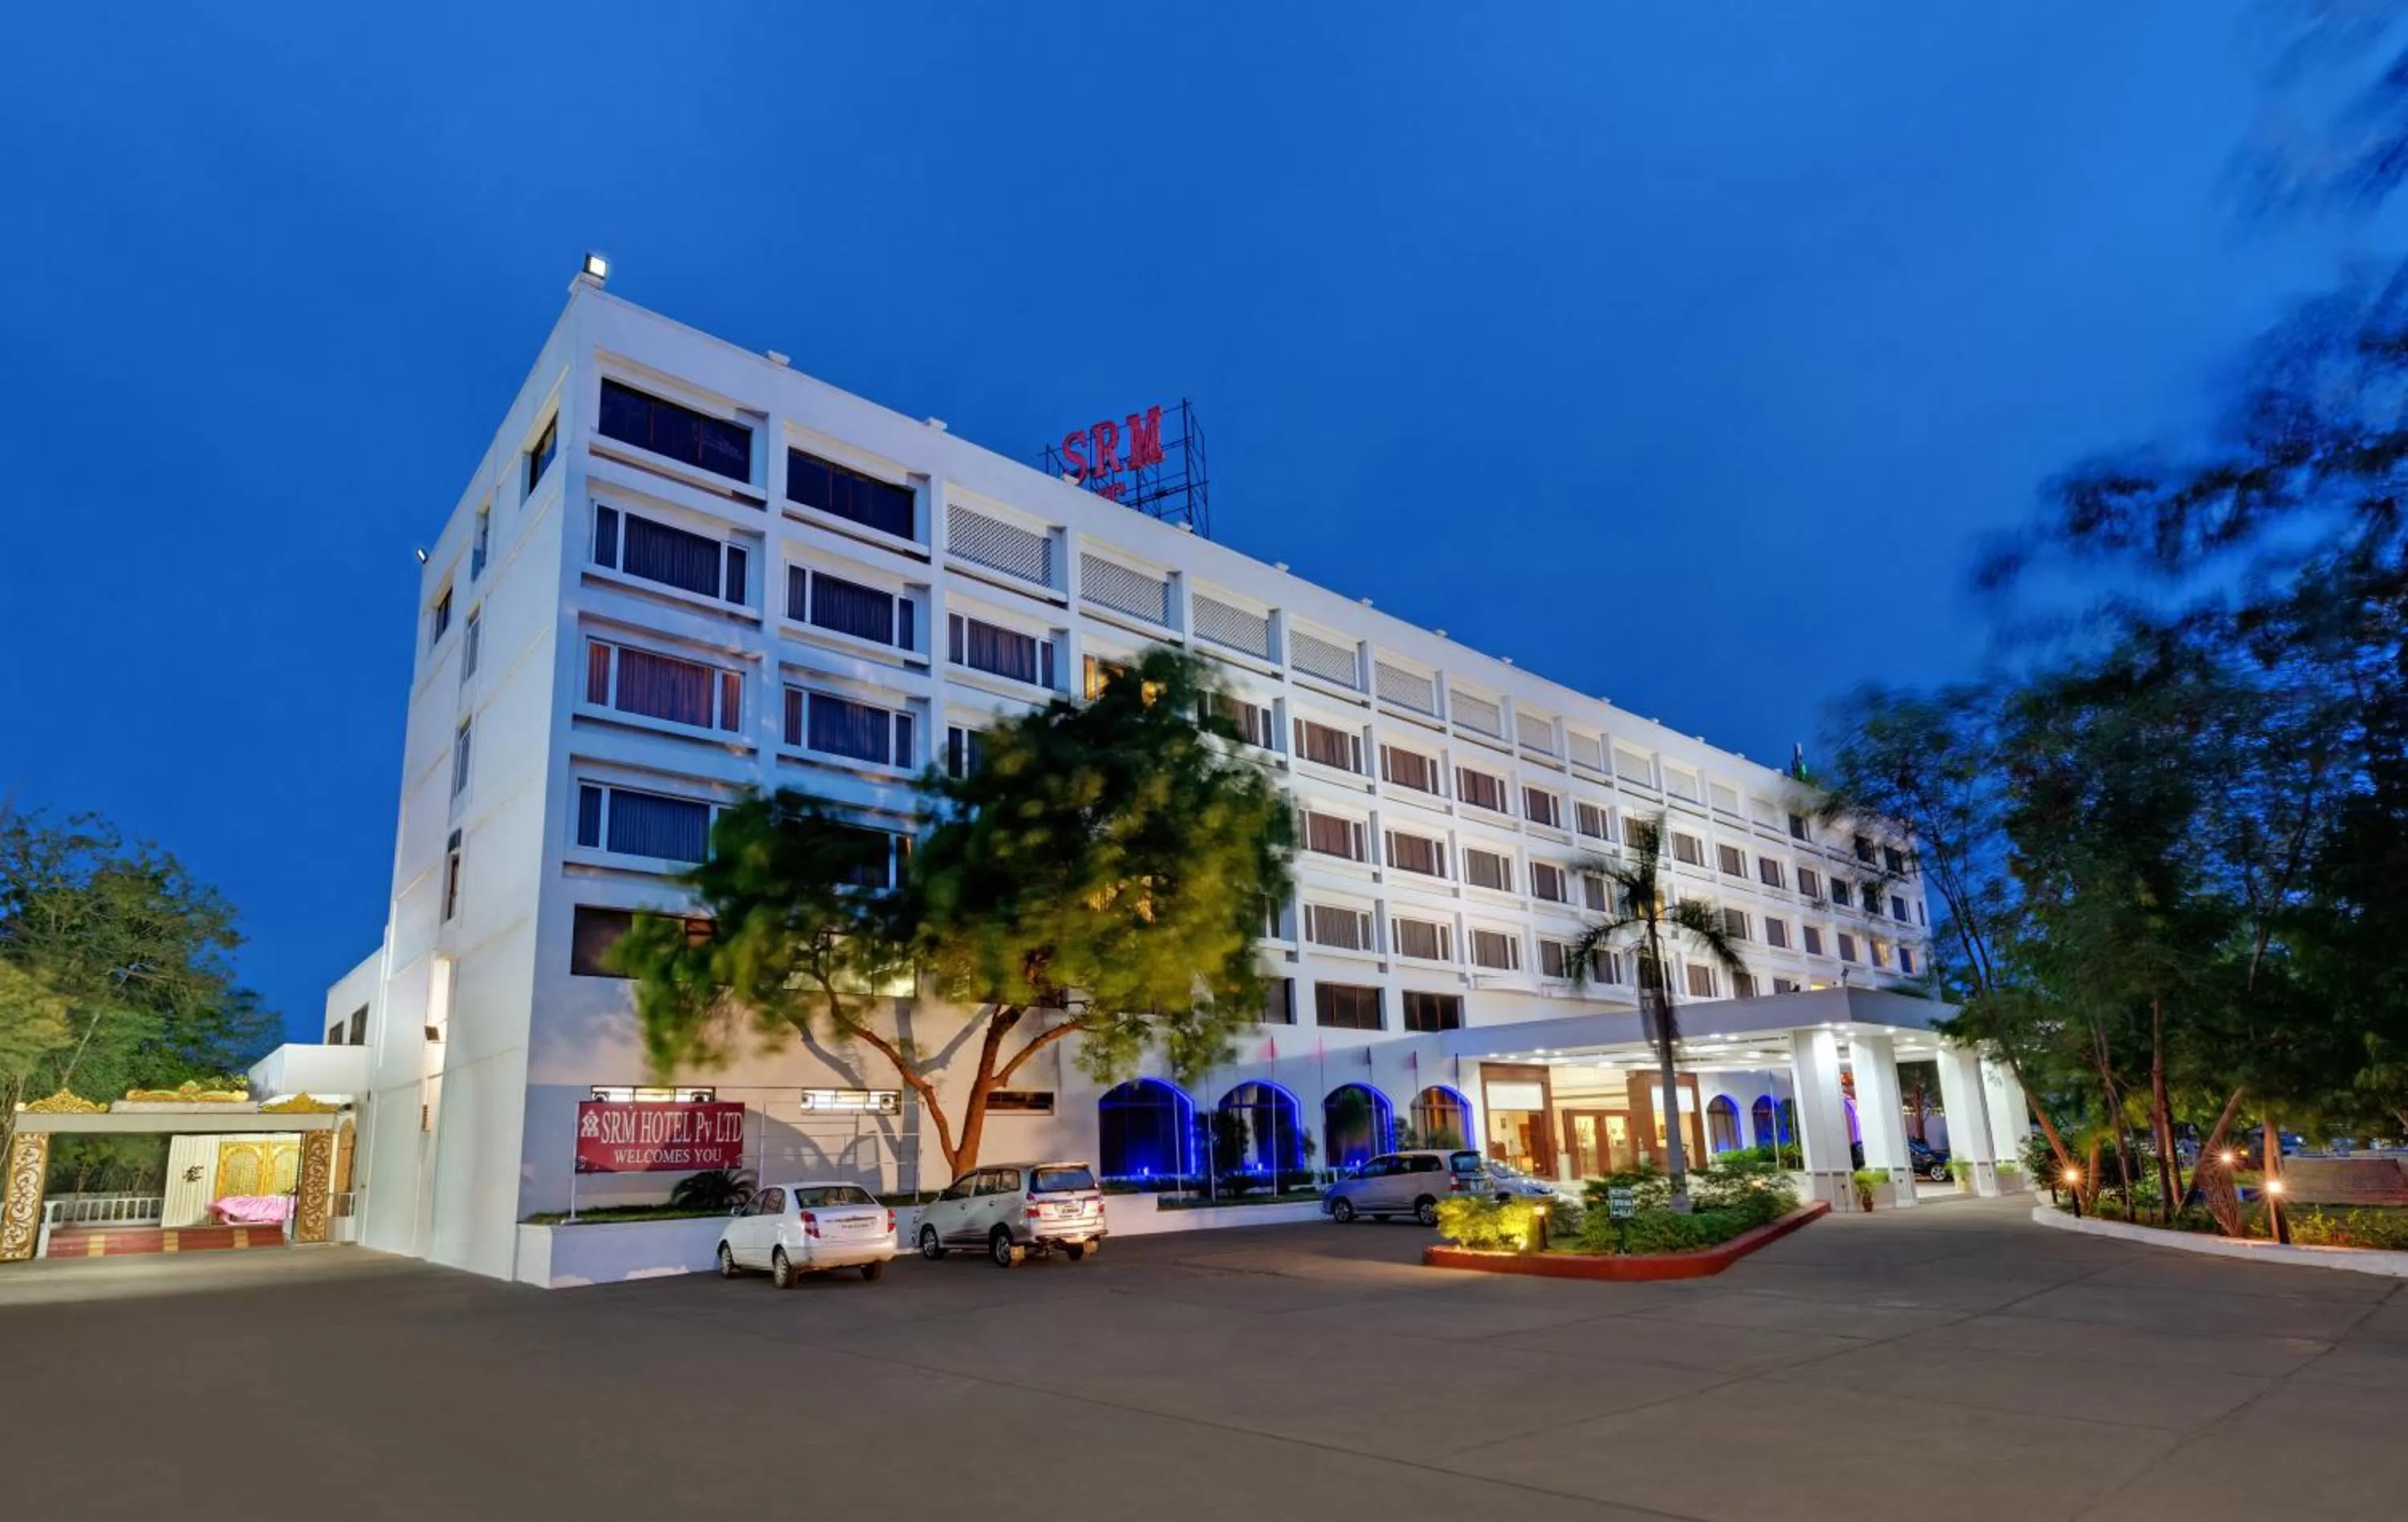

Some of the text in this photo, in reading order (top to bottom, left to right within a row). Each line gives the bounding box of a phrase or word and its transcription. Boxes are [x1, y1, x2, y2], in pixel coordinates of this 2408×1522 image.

[1062, 405, 1164, 485] SRM
[600, 1111, 637, 1144] SRM
[640, 1111, 691, 1144] HOTEL
[715, 1112, 742, 1142] LTD
[614, 1148, 722, 1164] WELCOMES YOU
